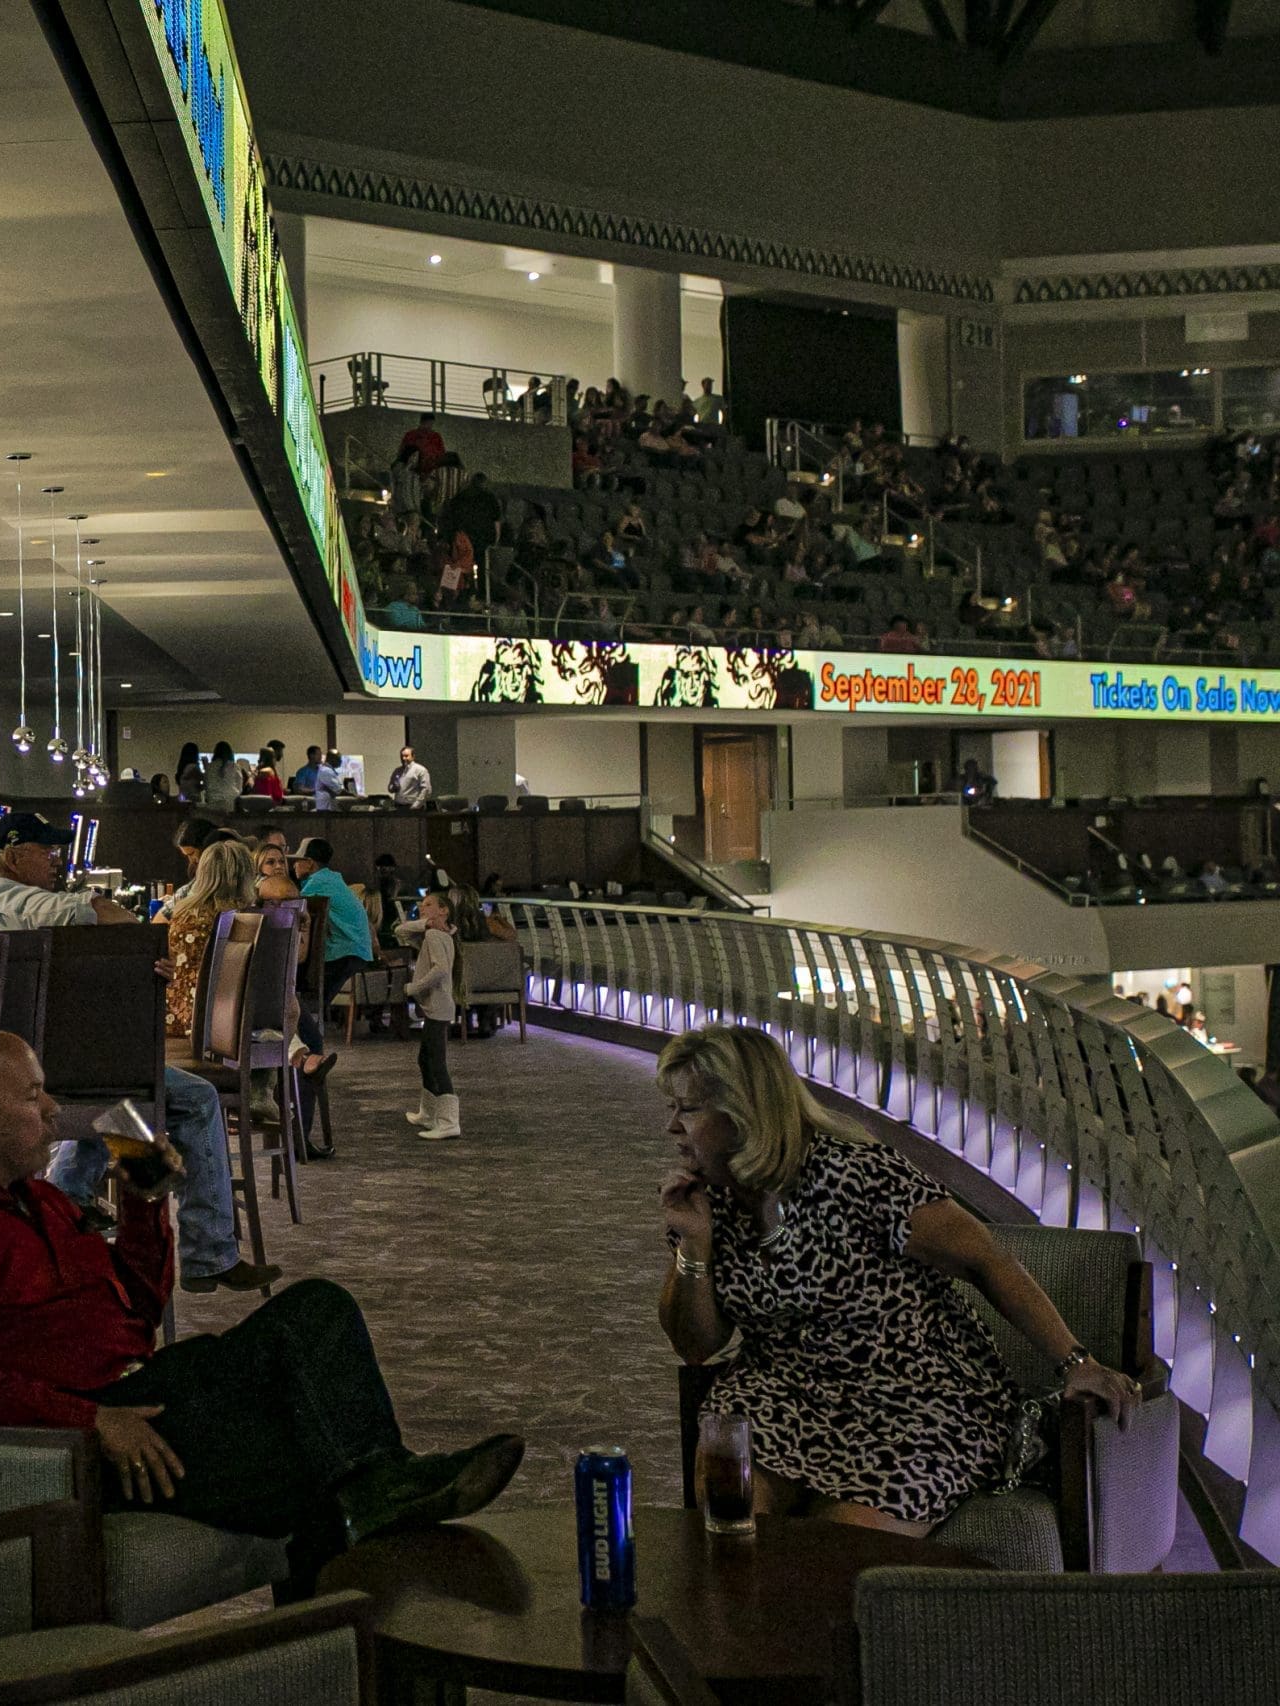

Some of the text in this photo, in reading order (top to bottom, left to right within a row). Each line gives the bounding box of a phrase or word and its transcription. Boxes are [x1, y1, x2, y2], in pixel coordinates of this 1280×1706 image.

[373, 641, 422, 690] ow!
[820, 662, 1042, 712] September 28, 2021
[1090, 671, 1158, 711] Tickets
[1162, 675, 1192, 712] On
[1195, 674, 1237, 712] Sale
[592, 1478, 611, 1581] BUD LIGHT
